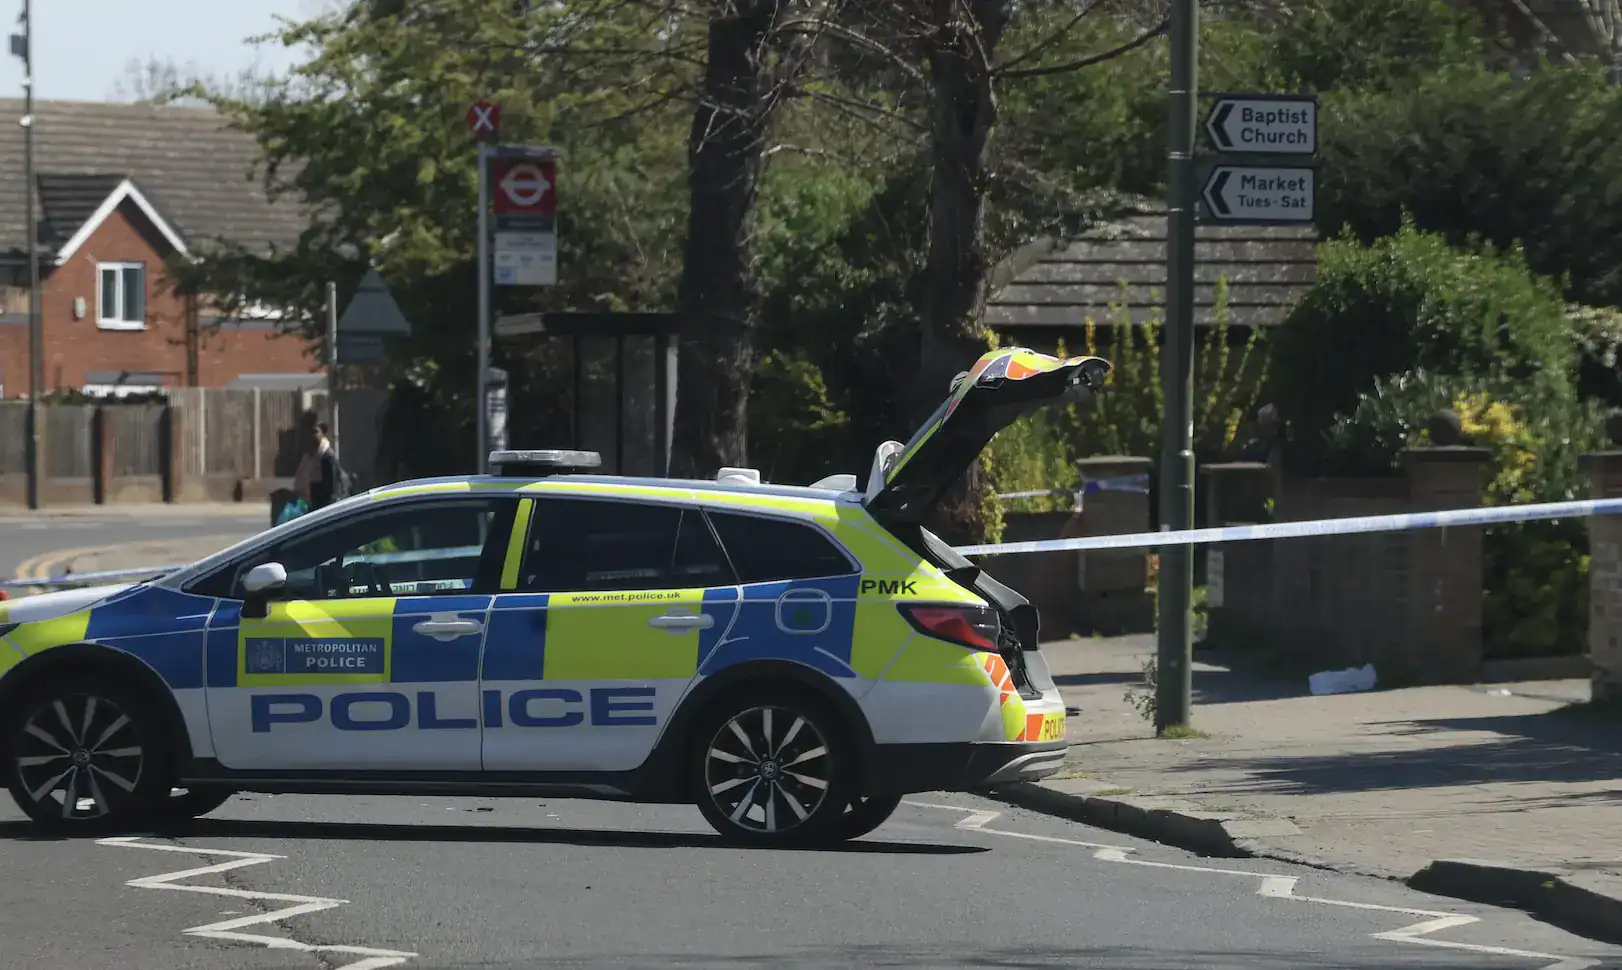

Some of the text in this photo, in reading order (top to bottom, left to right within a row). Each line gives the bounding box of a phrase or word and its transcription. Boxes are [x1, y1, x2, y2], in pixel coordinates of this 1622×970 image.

[474, 106, 493, 130] X
[1241, 107, 1308, 126] Baptist
[1241, 127, 1307, 143] Church
[1241, 175, 1305, 191] Market
[861, 579, 918, 595] PMK
[572, 592, 681, 602] www.met.police.uk
[294, 643, 377, 653] METROPOLITAN
[305, 656, 366, 668] POLICE
[251, 687, 657, 733] POLICE
